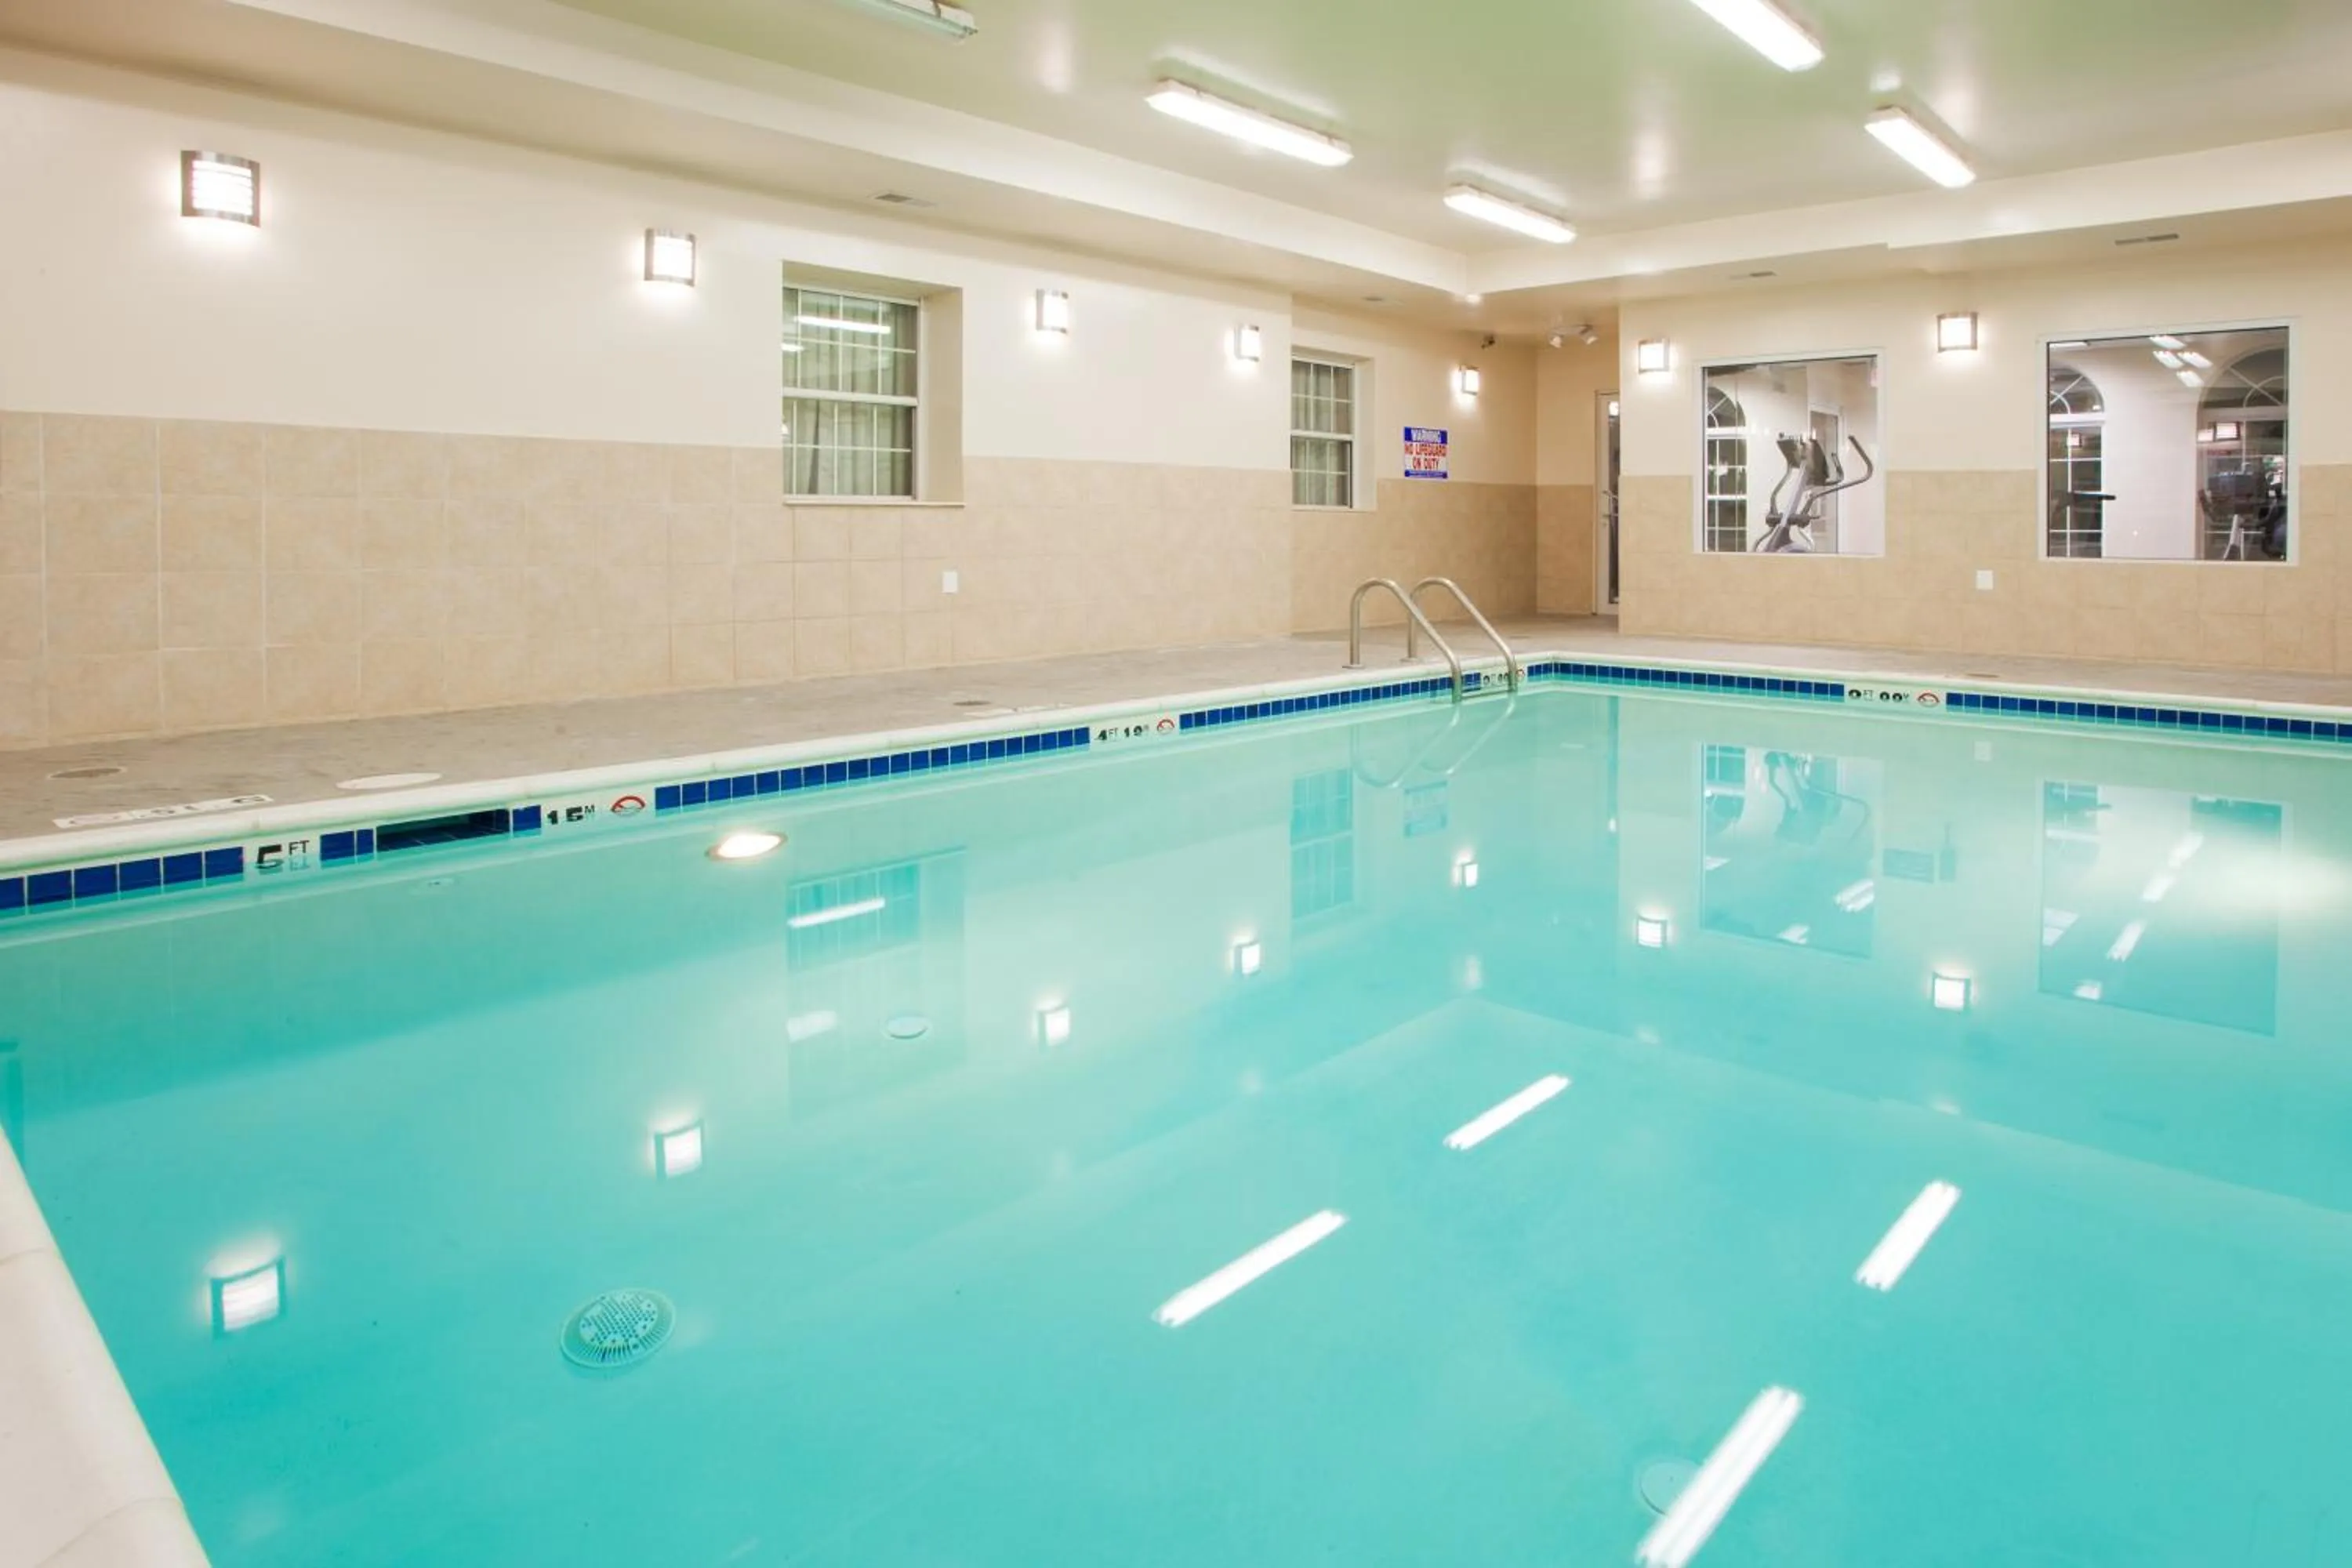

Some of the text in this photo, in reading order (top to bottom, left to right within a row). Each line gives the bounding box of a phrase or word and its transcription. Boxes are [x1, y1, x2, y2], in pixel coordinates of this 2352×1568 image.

[1411, 429, 1441, 444] WARNING
[1404, 443, 1446, 456] NO LIFEGUARD
[1412, 457, 1439, 470] ON DUTY
[255, 840, 310, 869] 5 FT
